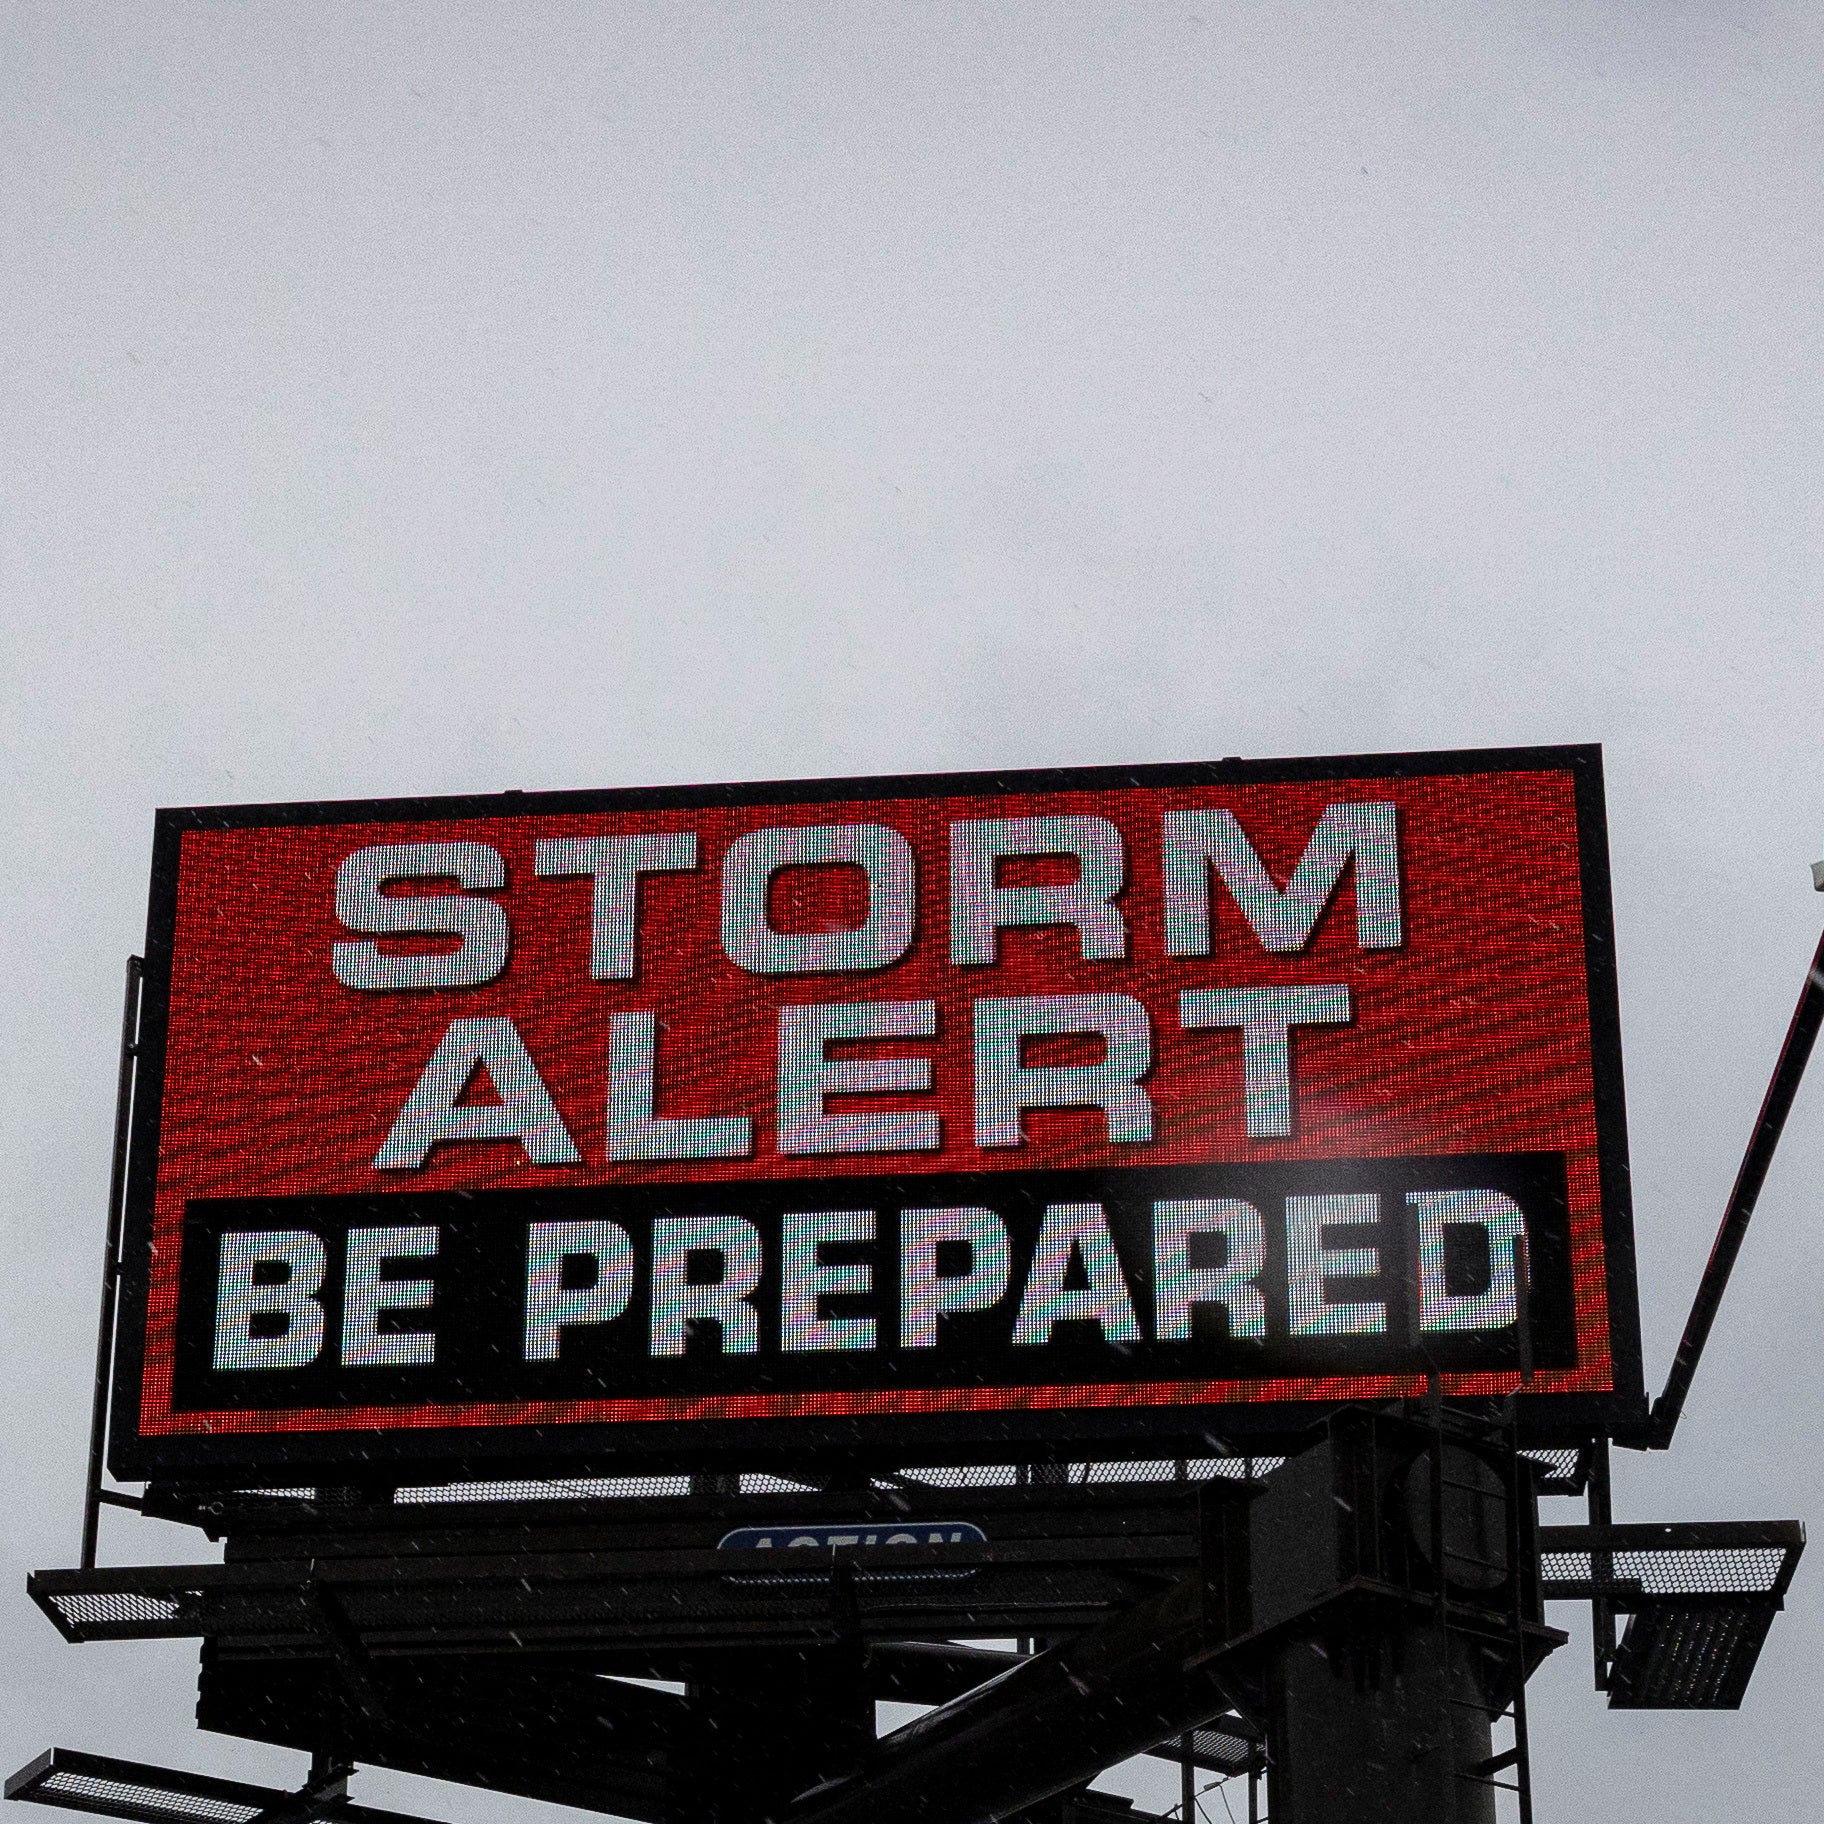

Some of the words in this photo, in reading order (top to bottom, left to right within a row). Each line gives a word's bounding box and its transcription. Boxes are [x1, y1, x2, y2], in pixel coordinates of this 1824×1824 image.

[330, 801, 1402, 992] STORM
[373, 984, 1356, 1172] ALERT
[210, 1224, 442, 1372] BE
[522, 1189, 1527, 1362] PREPARED
